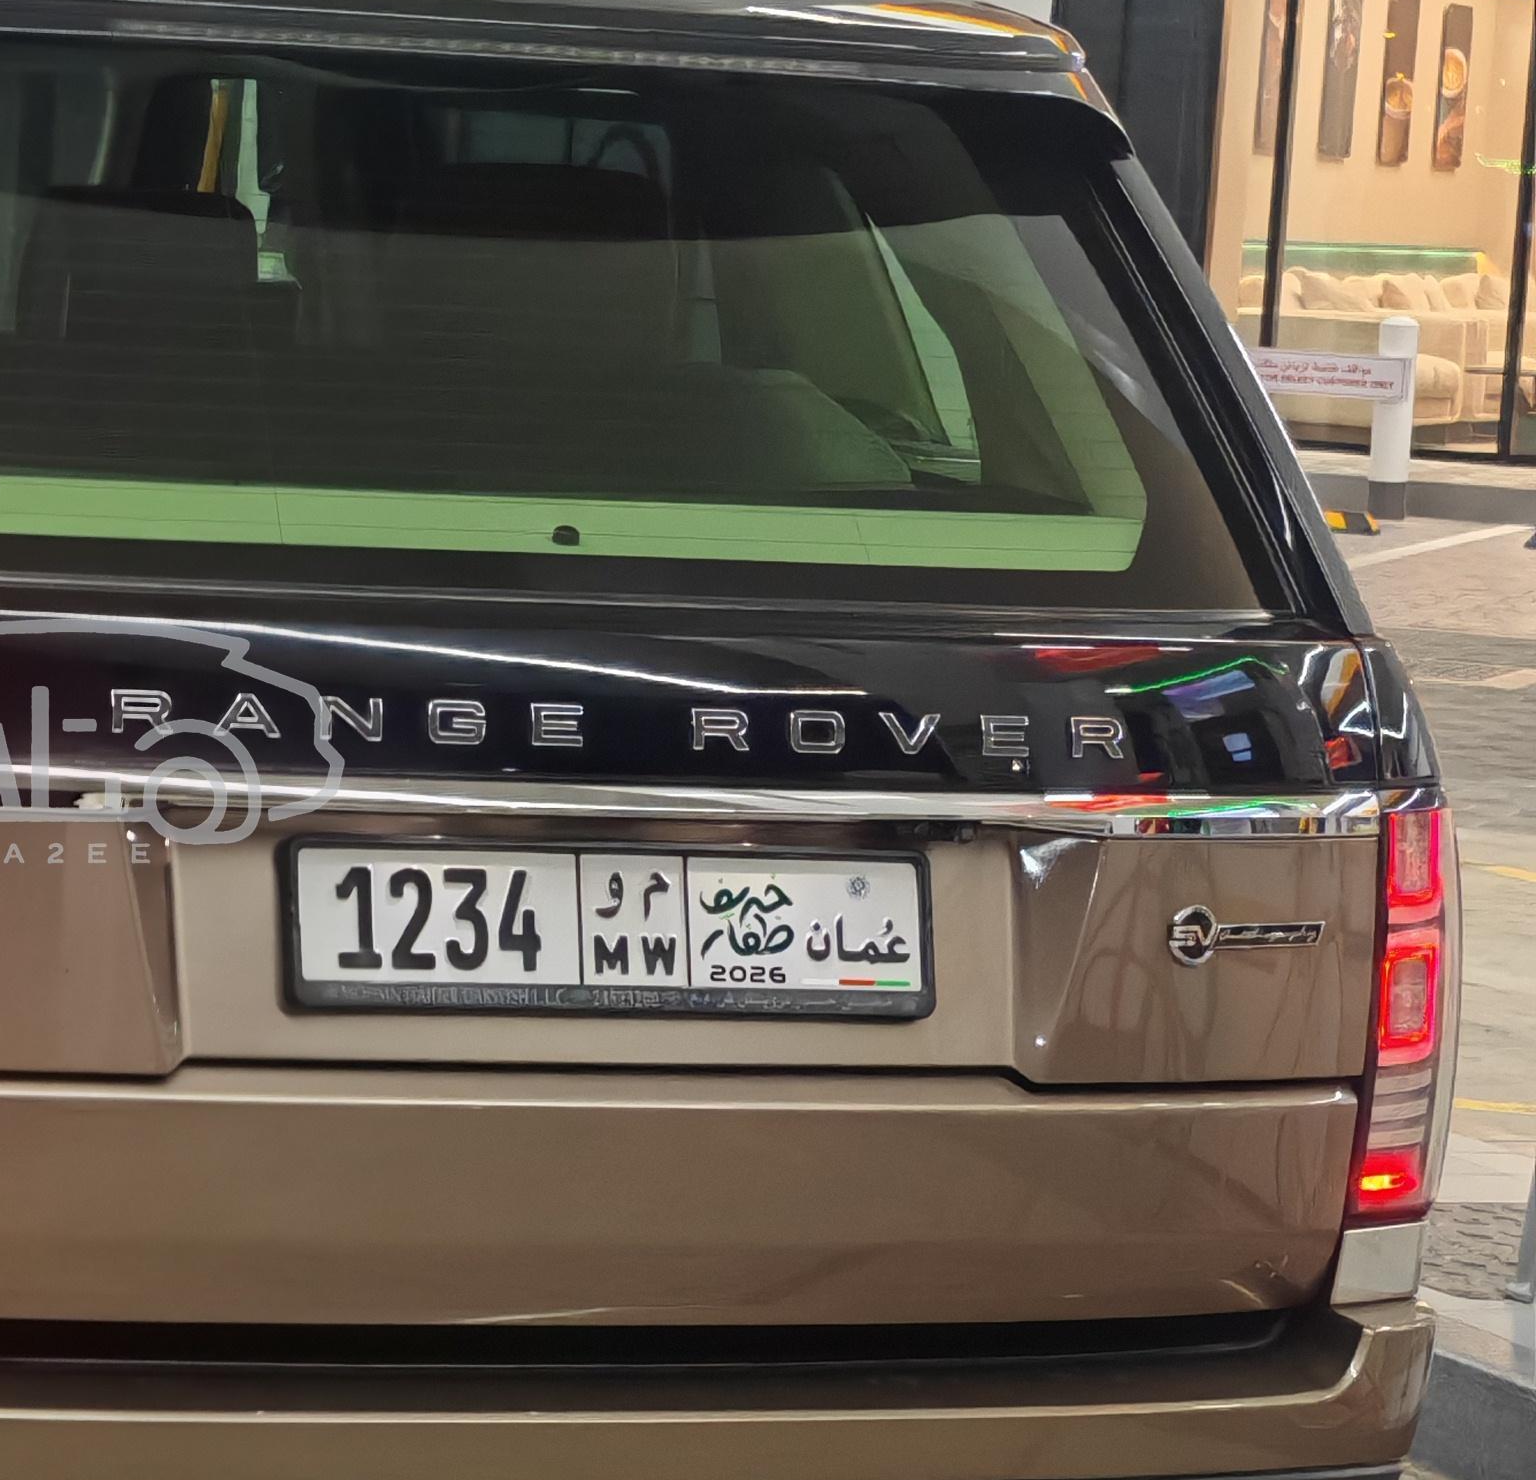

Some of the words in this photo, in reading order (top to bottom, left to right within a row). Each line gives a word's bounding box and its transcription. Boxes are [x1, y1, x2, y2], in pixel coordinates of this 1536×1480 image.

[110, 687, 585, 748] RANGE
[690, 706, 1125, 760] ROVER
[335, 866, 542, 973] 1234
[710, 964, 786, 984] 2026
